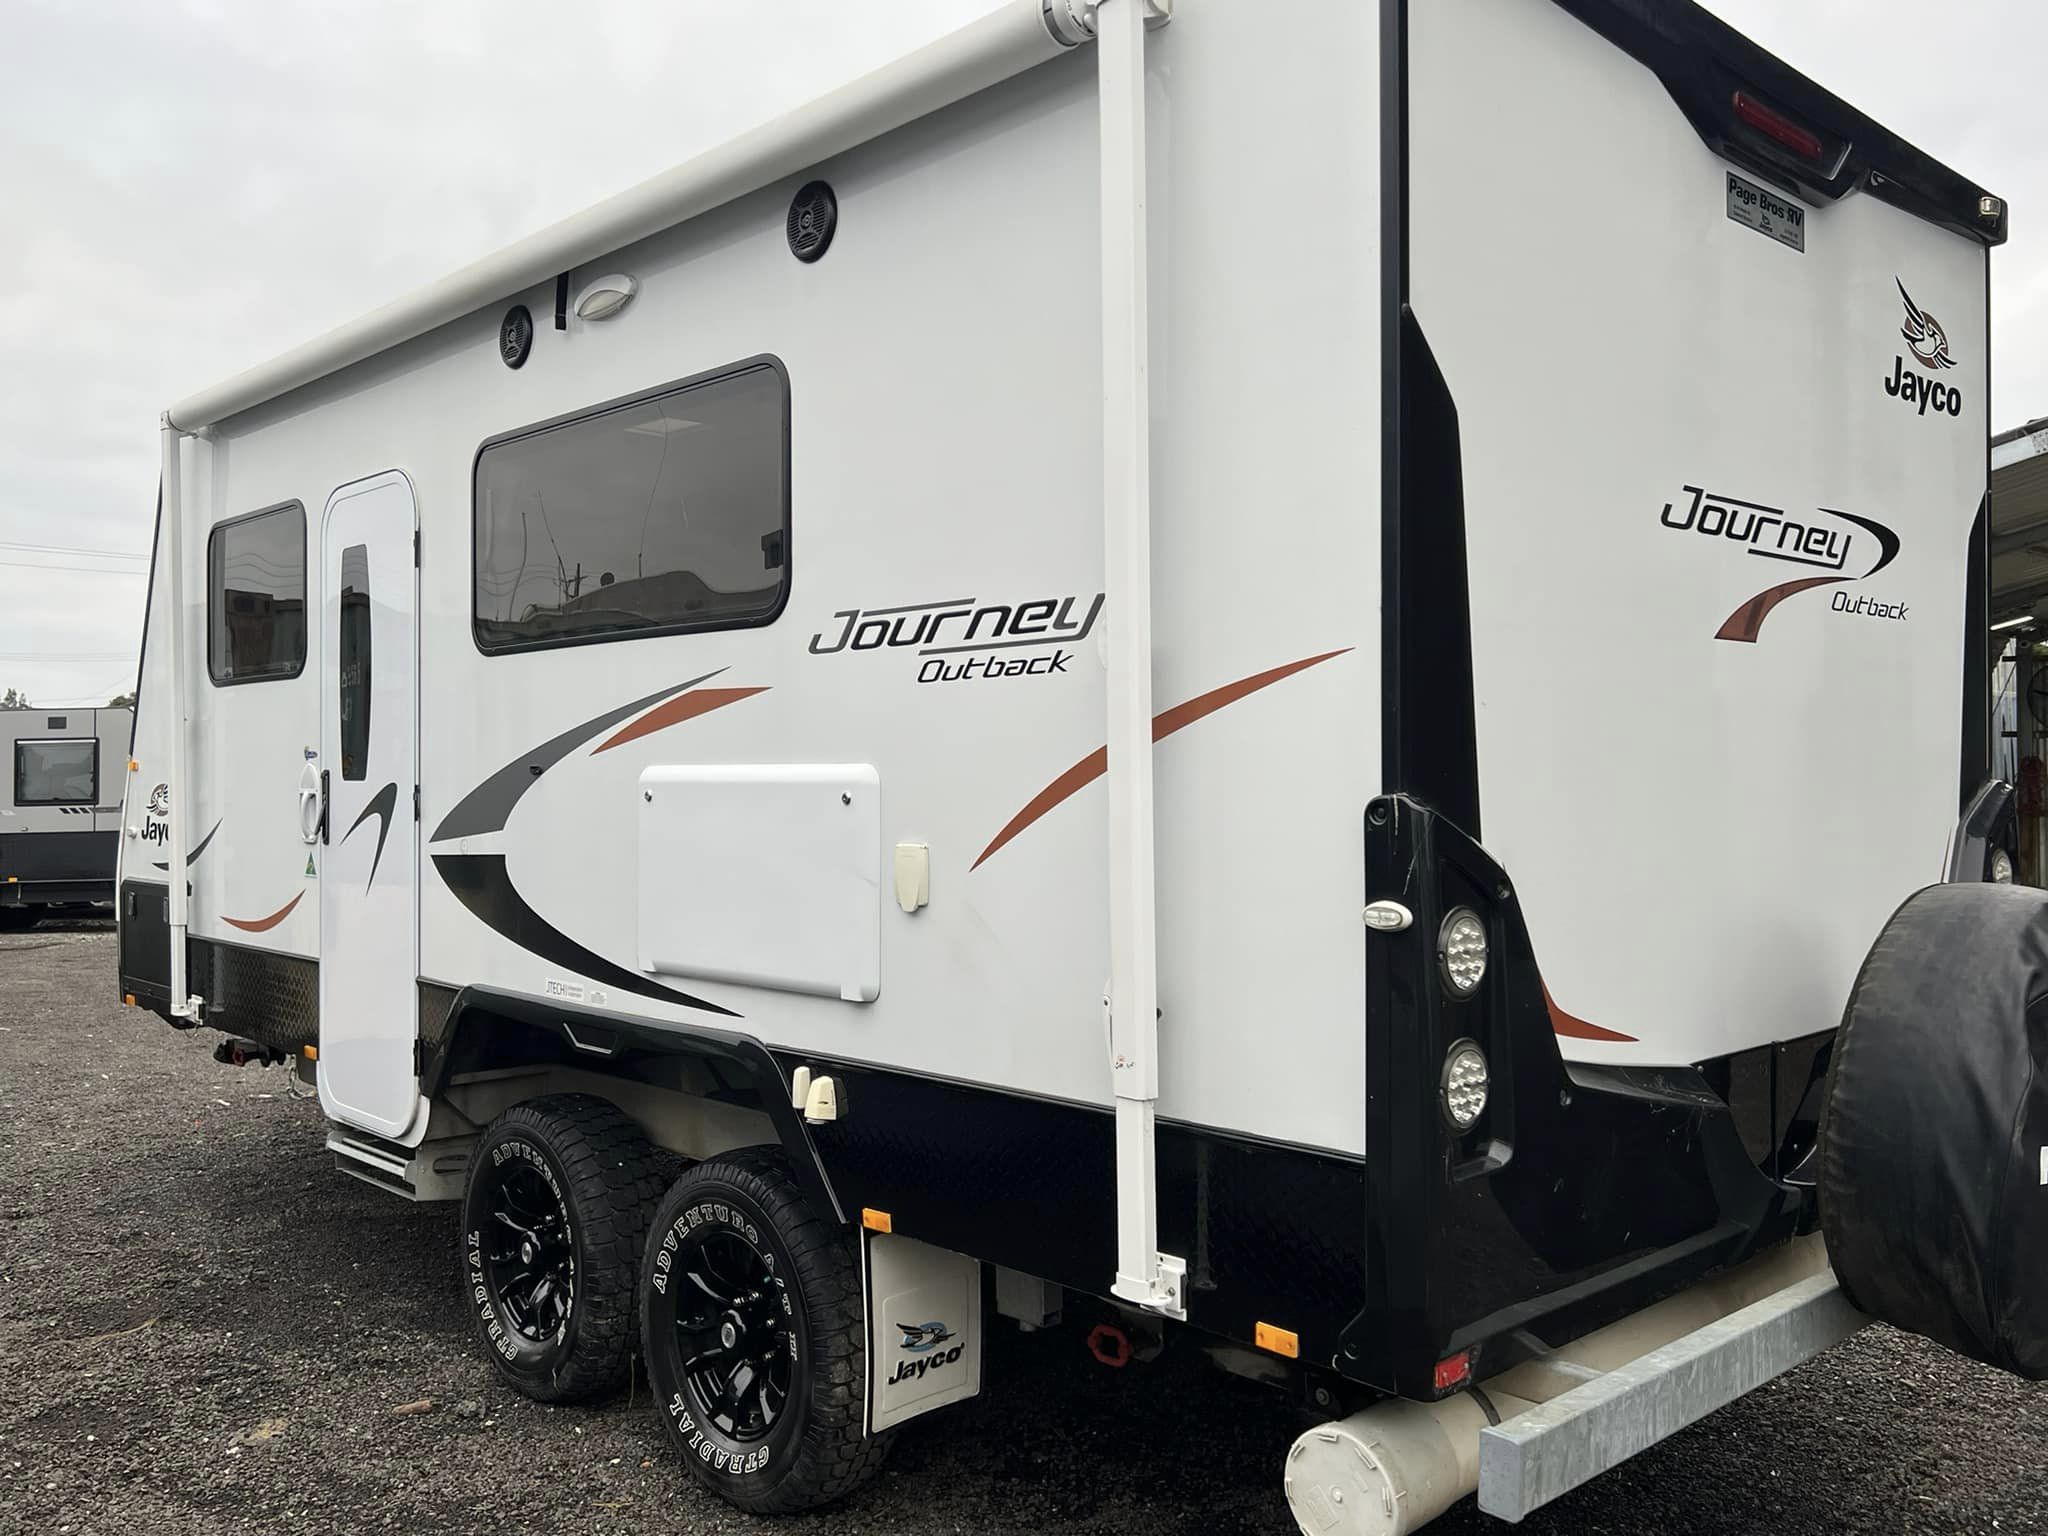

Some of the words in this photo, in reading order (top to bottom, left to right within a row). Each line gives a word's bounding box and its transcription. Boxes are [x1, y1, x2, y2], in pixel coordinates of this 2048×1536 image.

[1729, 178, 1757, 205] Page
[1760, 194, 1785, 218] Bros
[1885, 355, 1961, 417] Jayco
[1661, 484, 1852, 570] Journey
[808, 593, 1106, 655] Journey
[1831, 591, 1909, 620] Outback
[917, 650, 1075, 683] Outback
[653, 1204, 759, 1294] ADVENTURO
[888, 1346, 962, 1385] Jayco
[669, 1393, 770, 1474] GTRADIAL
